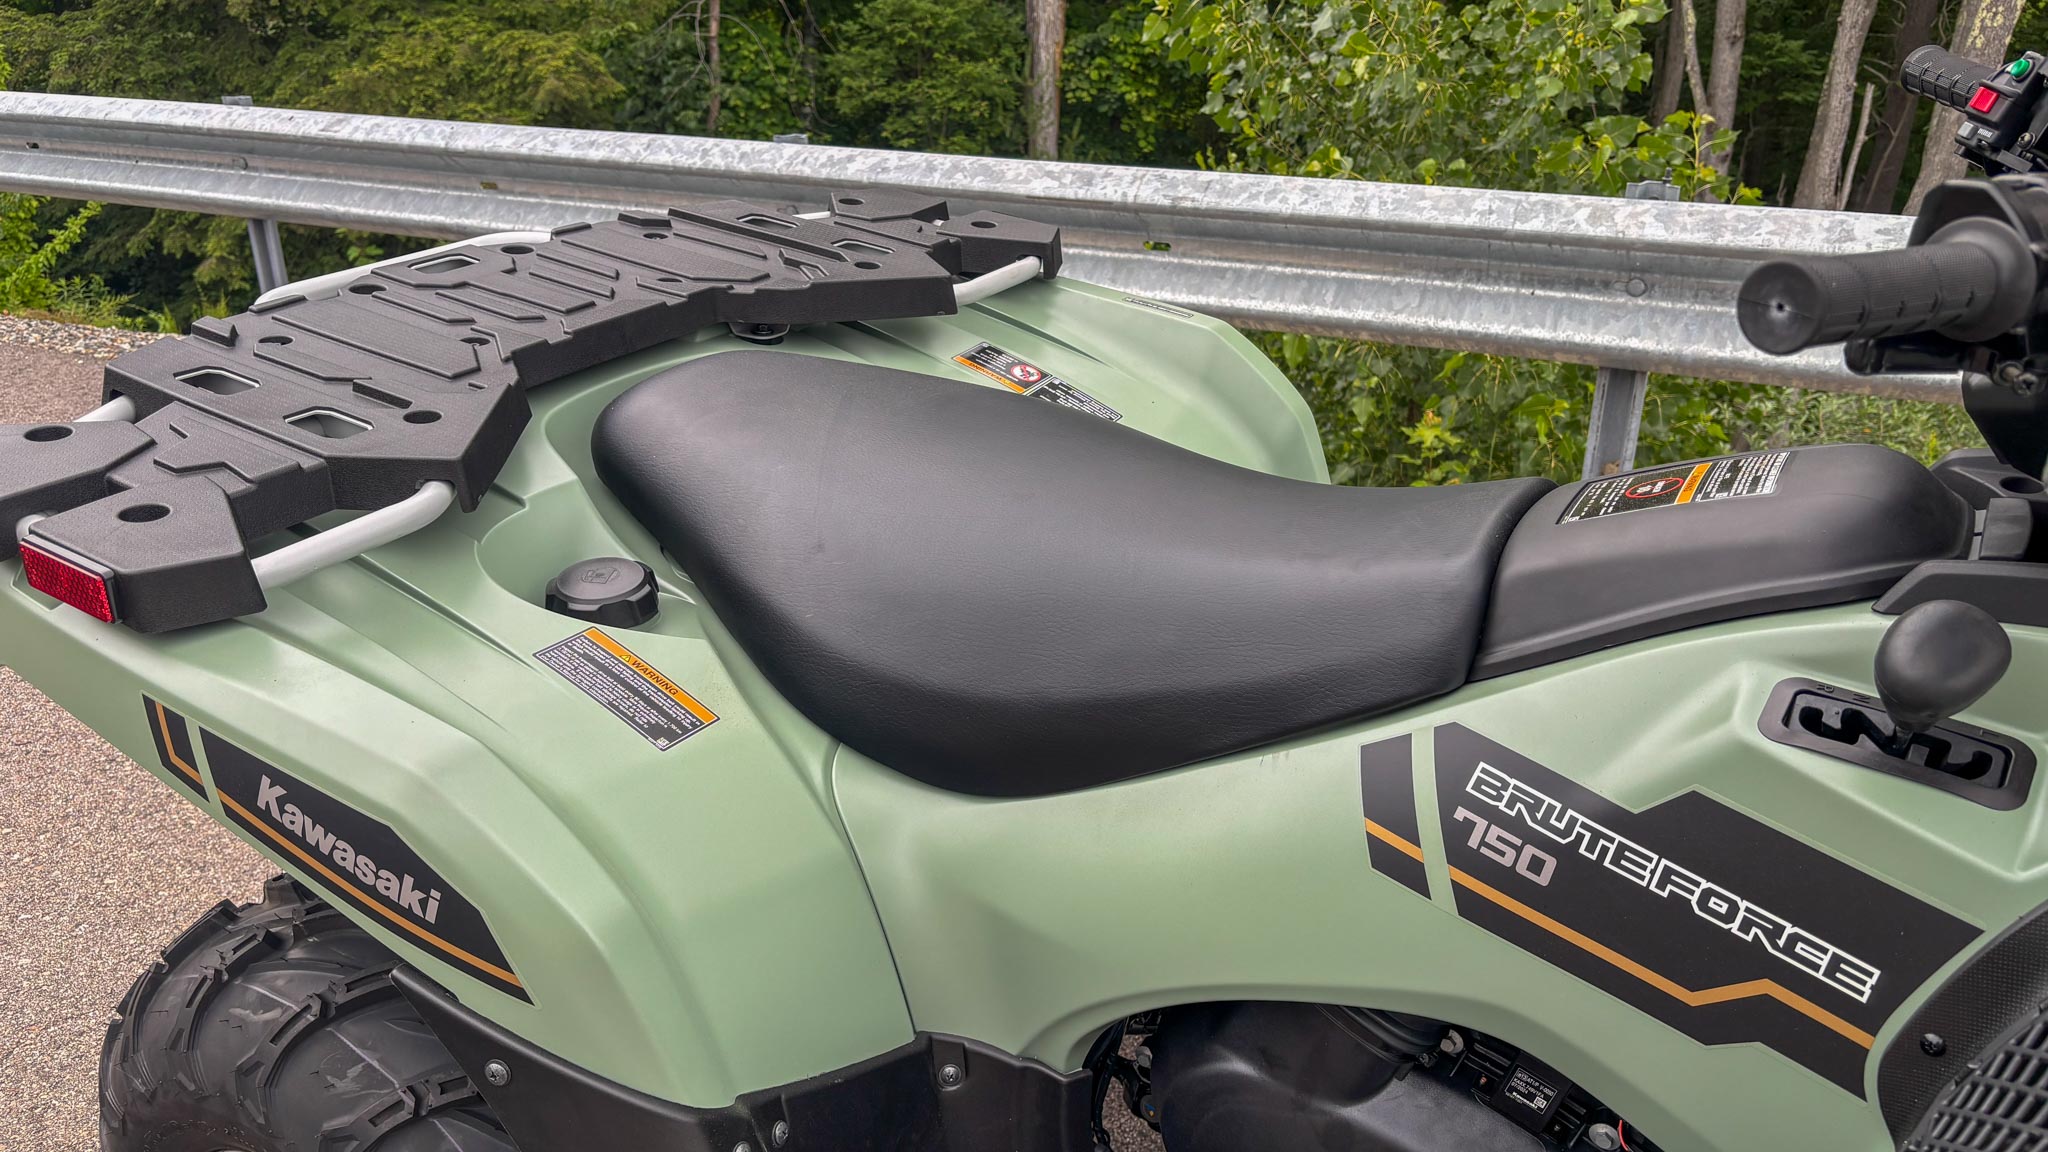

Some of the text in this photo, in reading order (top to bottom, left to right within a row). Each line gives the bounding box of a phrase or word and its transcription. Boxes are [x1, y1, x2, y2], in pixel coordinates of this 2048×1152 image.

[630, 660, 679, 695] WARNING
[256, 774, 442, 925] Kawasaki
[1451, 805, 1558, 888] 750
